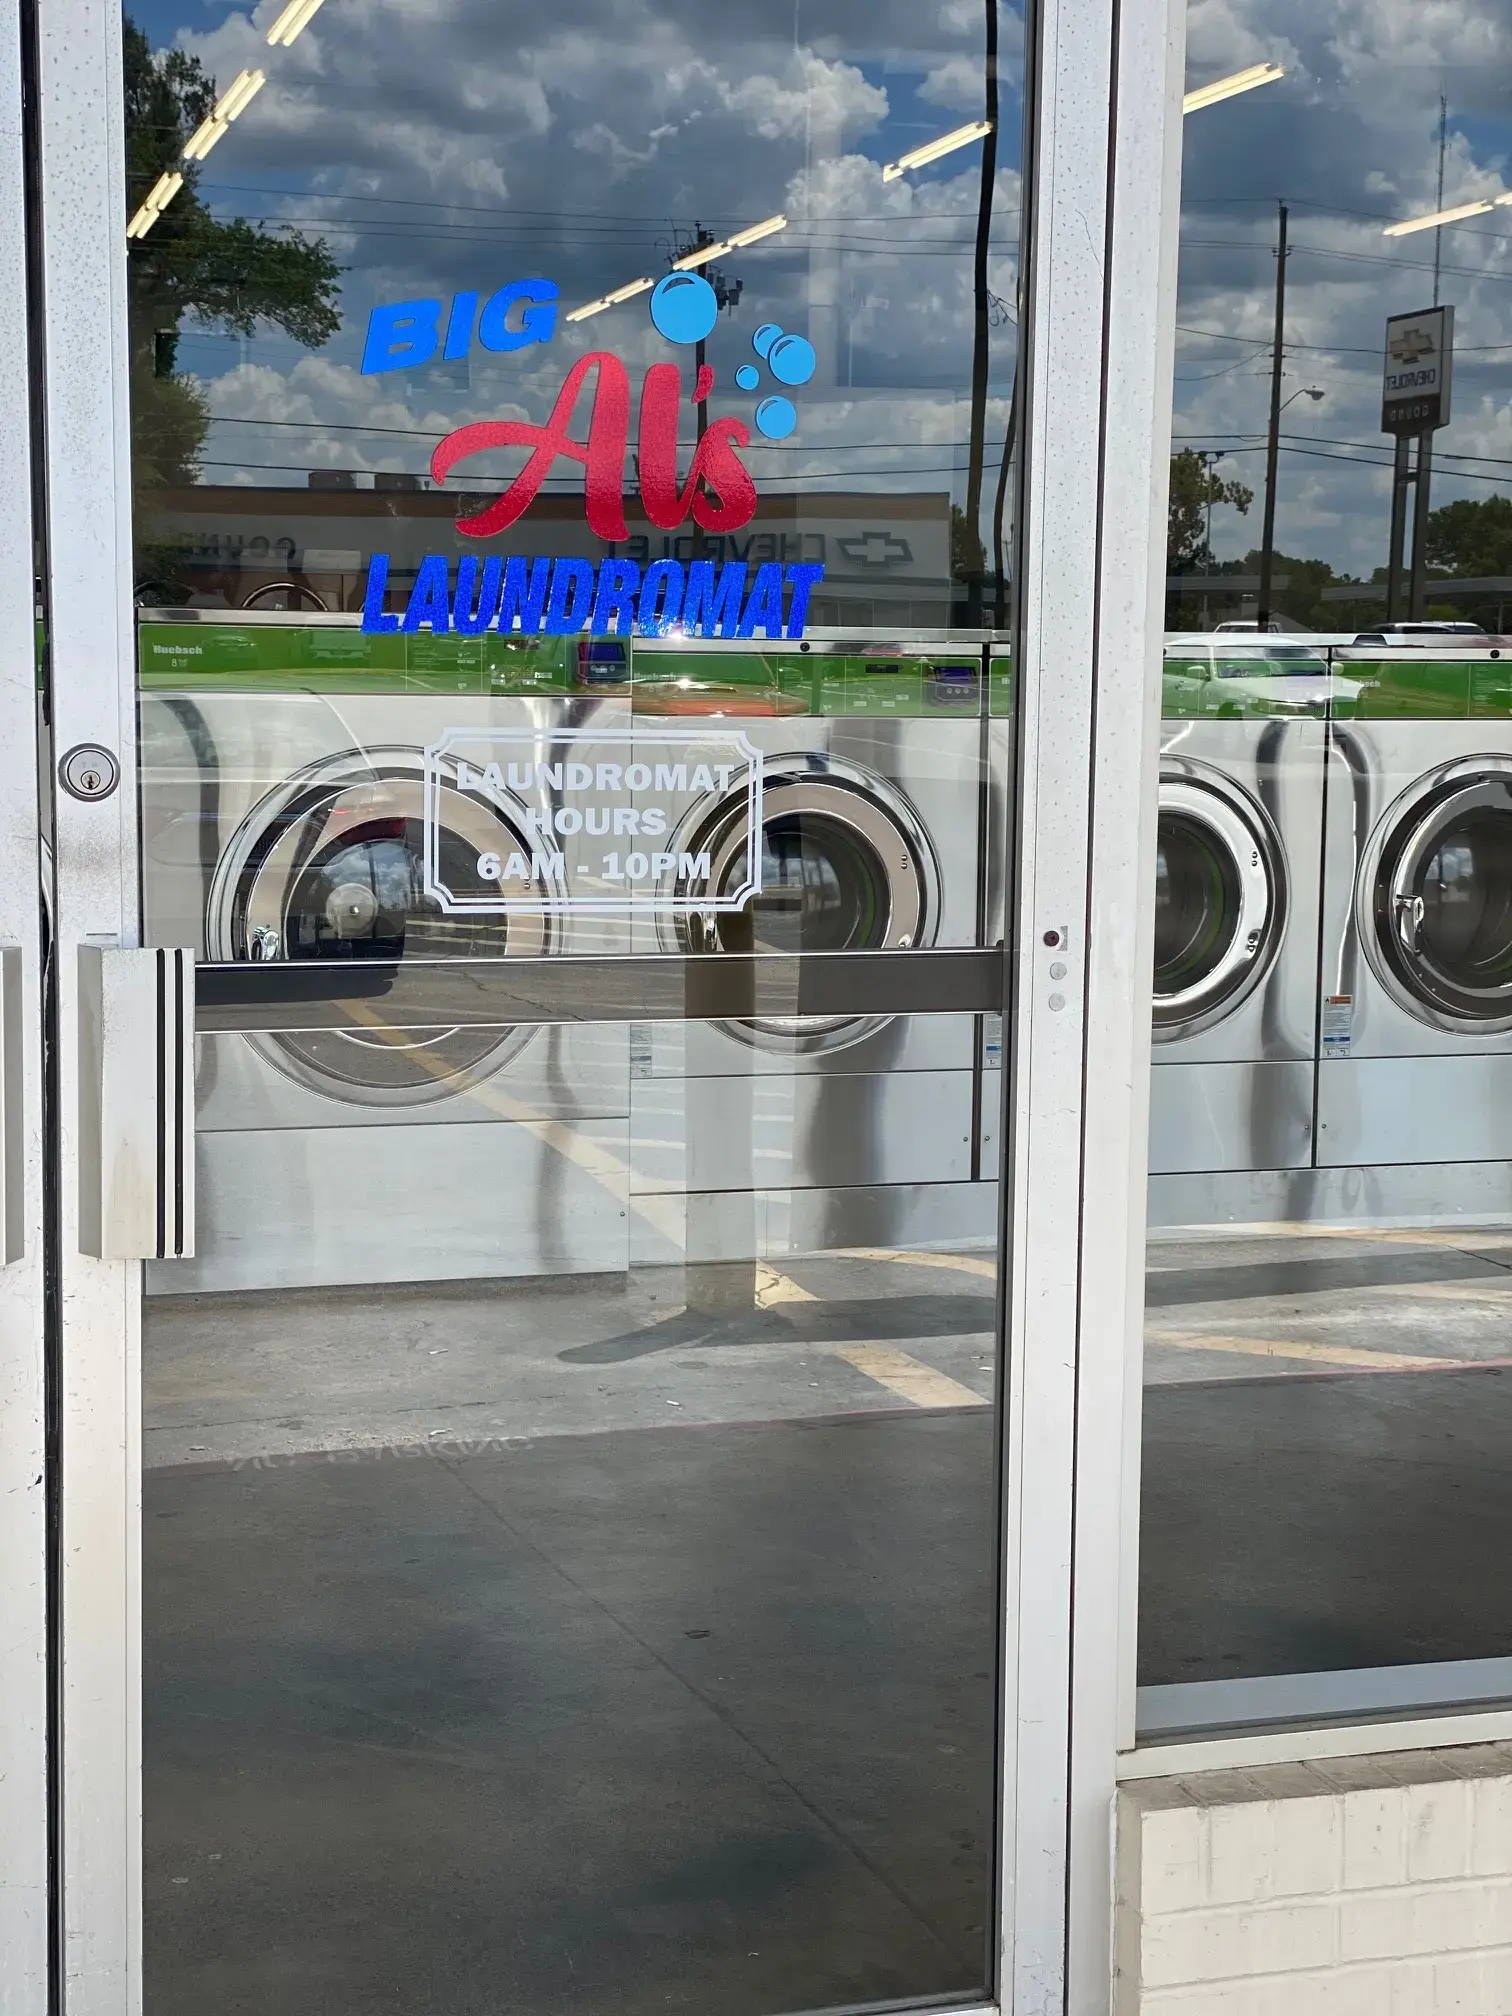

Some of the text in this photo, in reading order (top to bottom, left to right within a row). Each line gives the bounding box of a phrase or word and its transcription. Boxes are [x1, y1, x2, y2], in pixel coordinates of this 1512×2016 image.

[361, 277, 559, 375] BIG
[430, 351, 757, 541] Al's
[361, 552, 825, 639] LAUNDROMAT
[152, 644, 203, 655] Huebsch
[456, 763, 734, 792] LAUNDROMAT
[525, 807, 667, 836] HOURS
[476, 852, 565, 880] 6AM
[602, 851, 711, 880] 10PM
